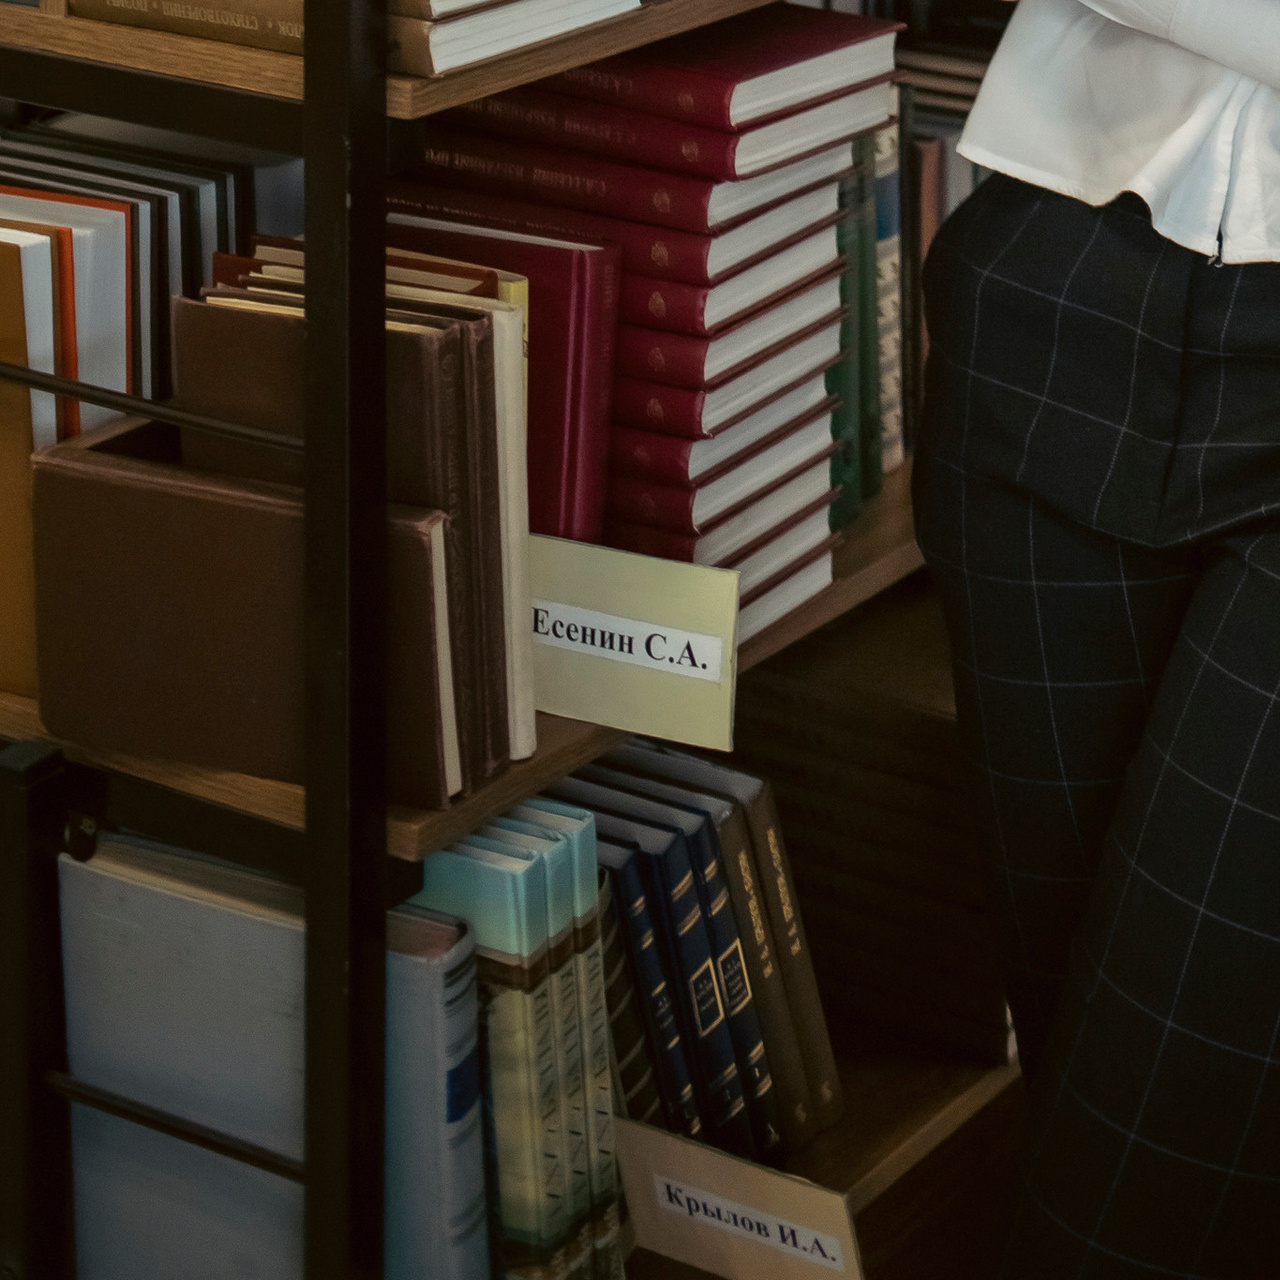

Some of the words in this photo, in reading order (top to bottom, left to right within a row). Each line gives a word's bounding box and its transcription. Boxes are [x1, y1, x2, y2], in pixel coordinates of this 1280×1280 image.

[532, 606, 635, 655] Есенин
[645, 633, 707, 670] С.А.
[663, 1183, 770, 1241] Крылов
[777, 1221, 838, 1264] И.А.
